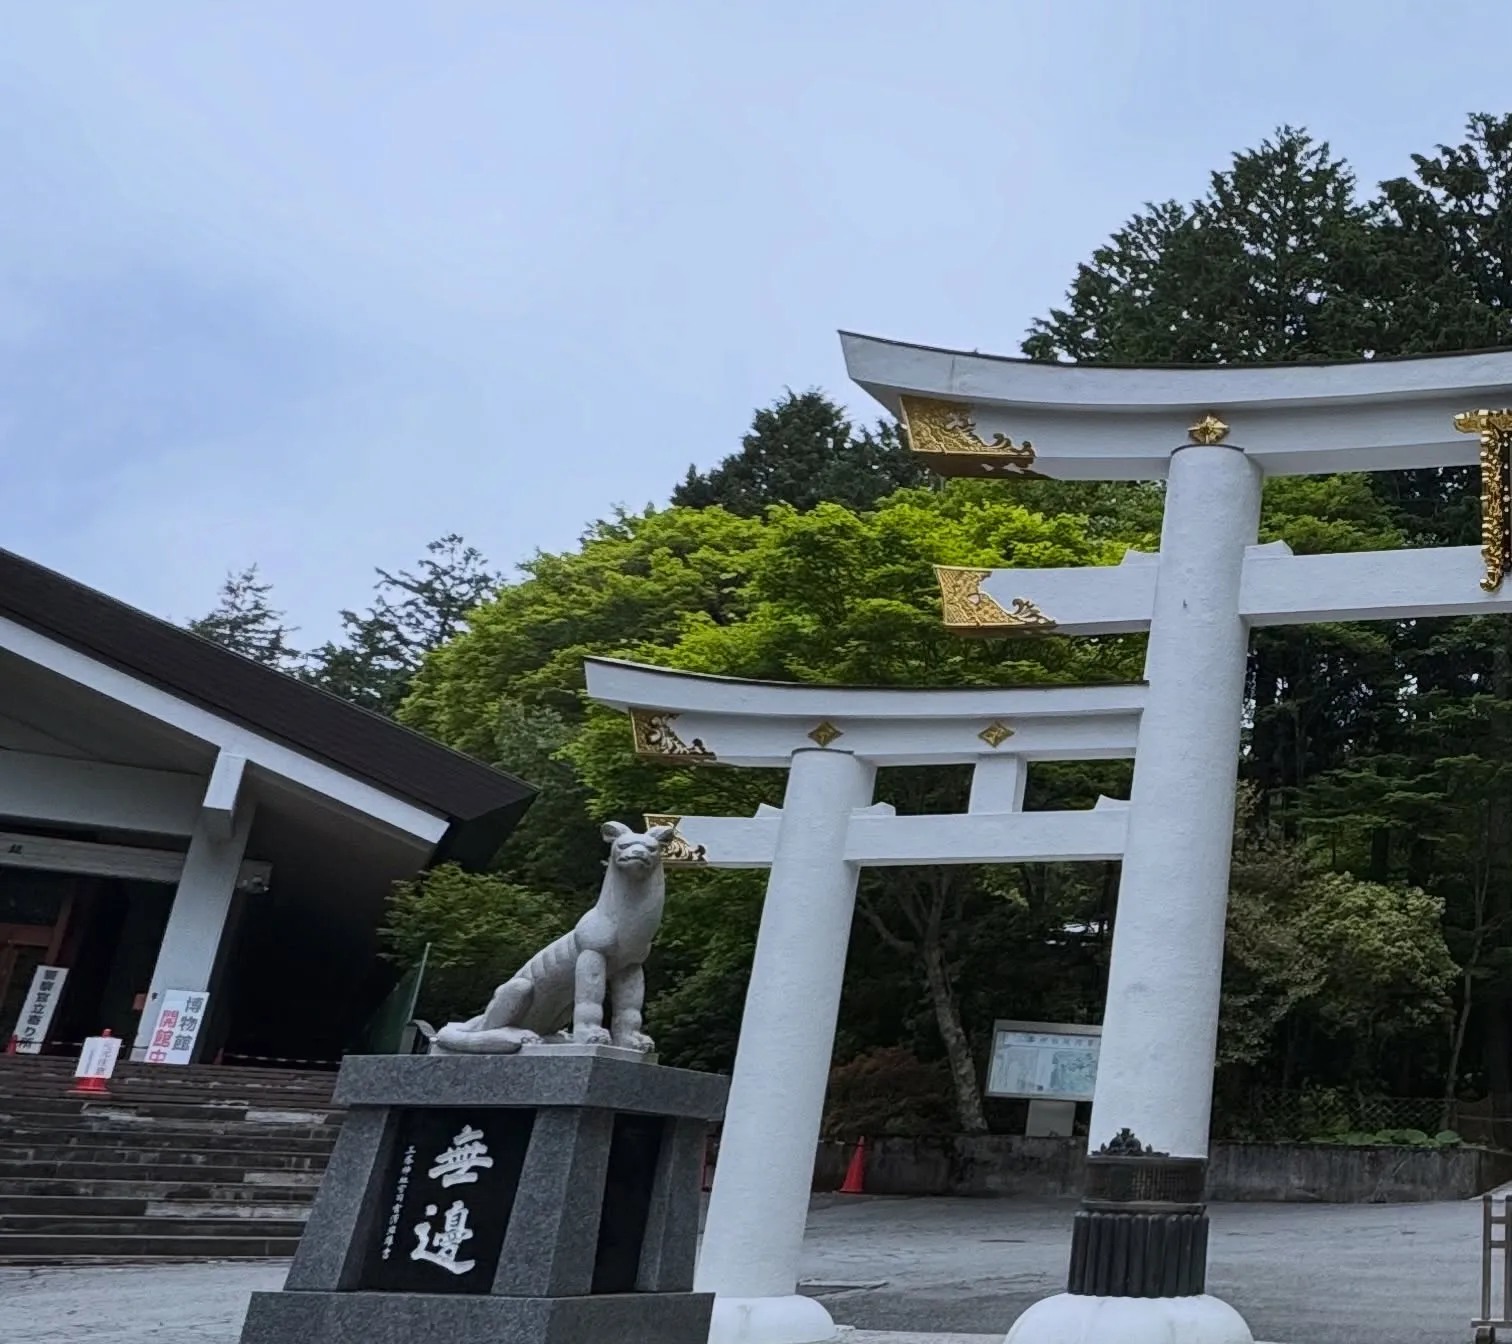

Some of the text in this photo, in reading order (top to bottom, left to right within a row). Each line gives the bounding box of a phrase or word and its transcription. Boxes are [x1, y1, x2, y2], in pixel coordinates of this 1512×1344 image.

[149, 1009, 180, 1063] 開館中
[171, 996, 204, 1051] 博物館
